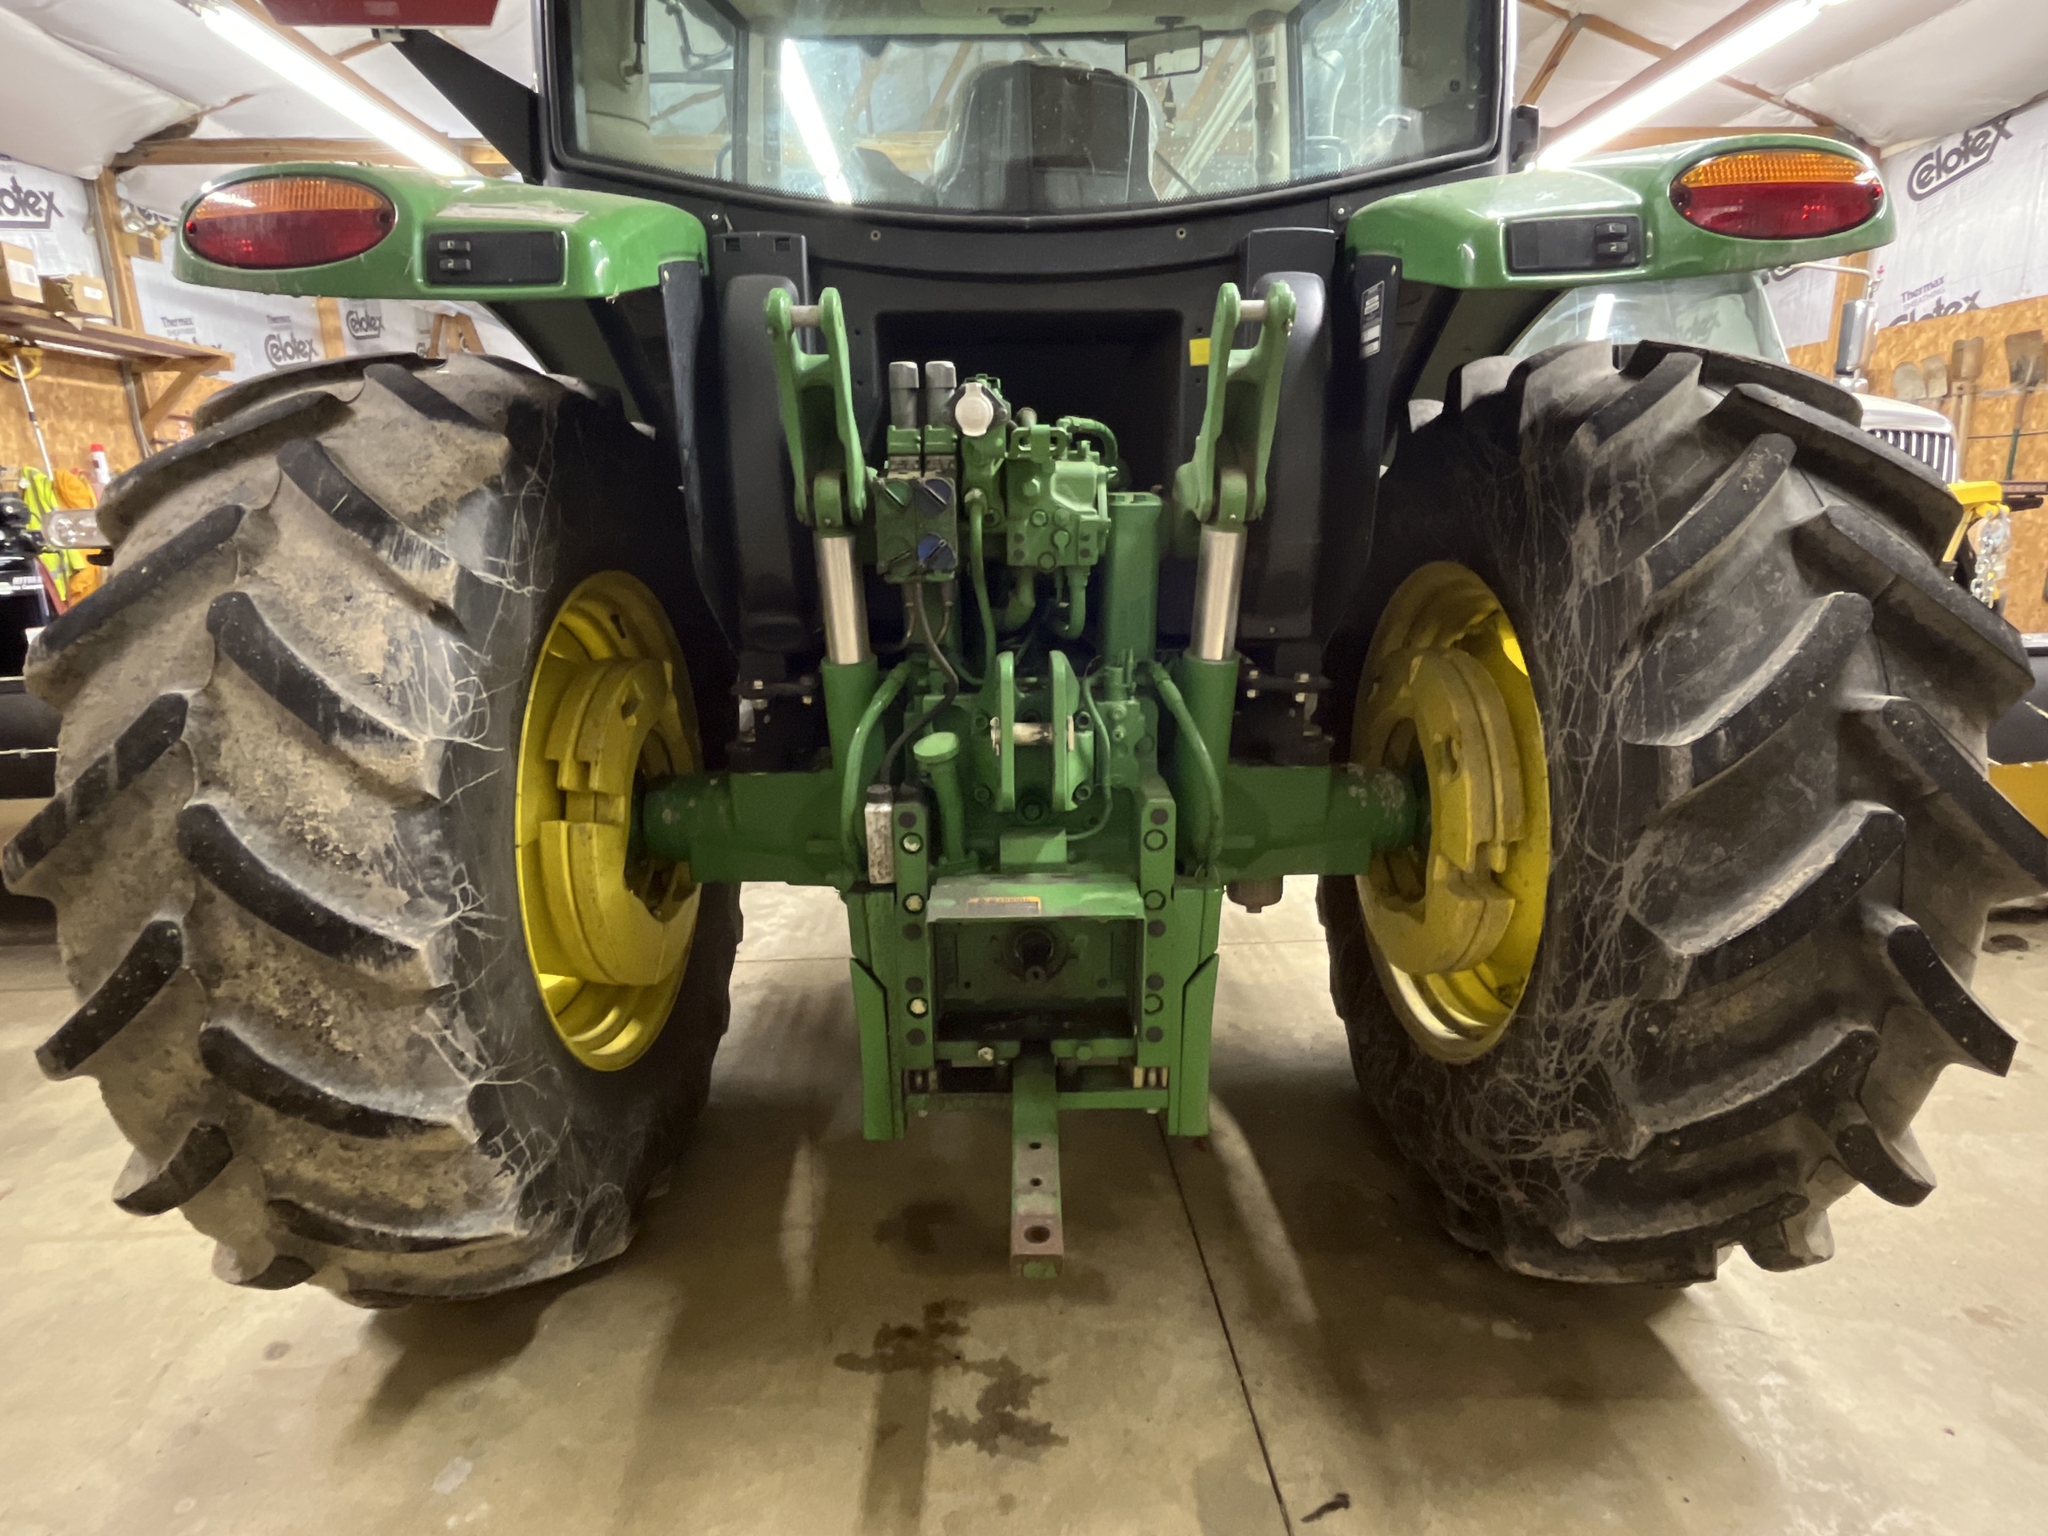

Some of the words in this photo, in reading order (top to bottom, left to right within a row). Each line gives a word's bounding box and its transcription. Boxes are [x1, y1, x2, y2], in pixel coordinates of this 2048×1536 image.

[1907, 115, 2014, 202] Celotex
[0, 175, 64, 230] otex
[1901, 276, 1945, 303] Thermax
[264, 332, 318, 369] Celotex
